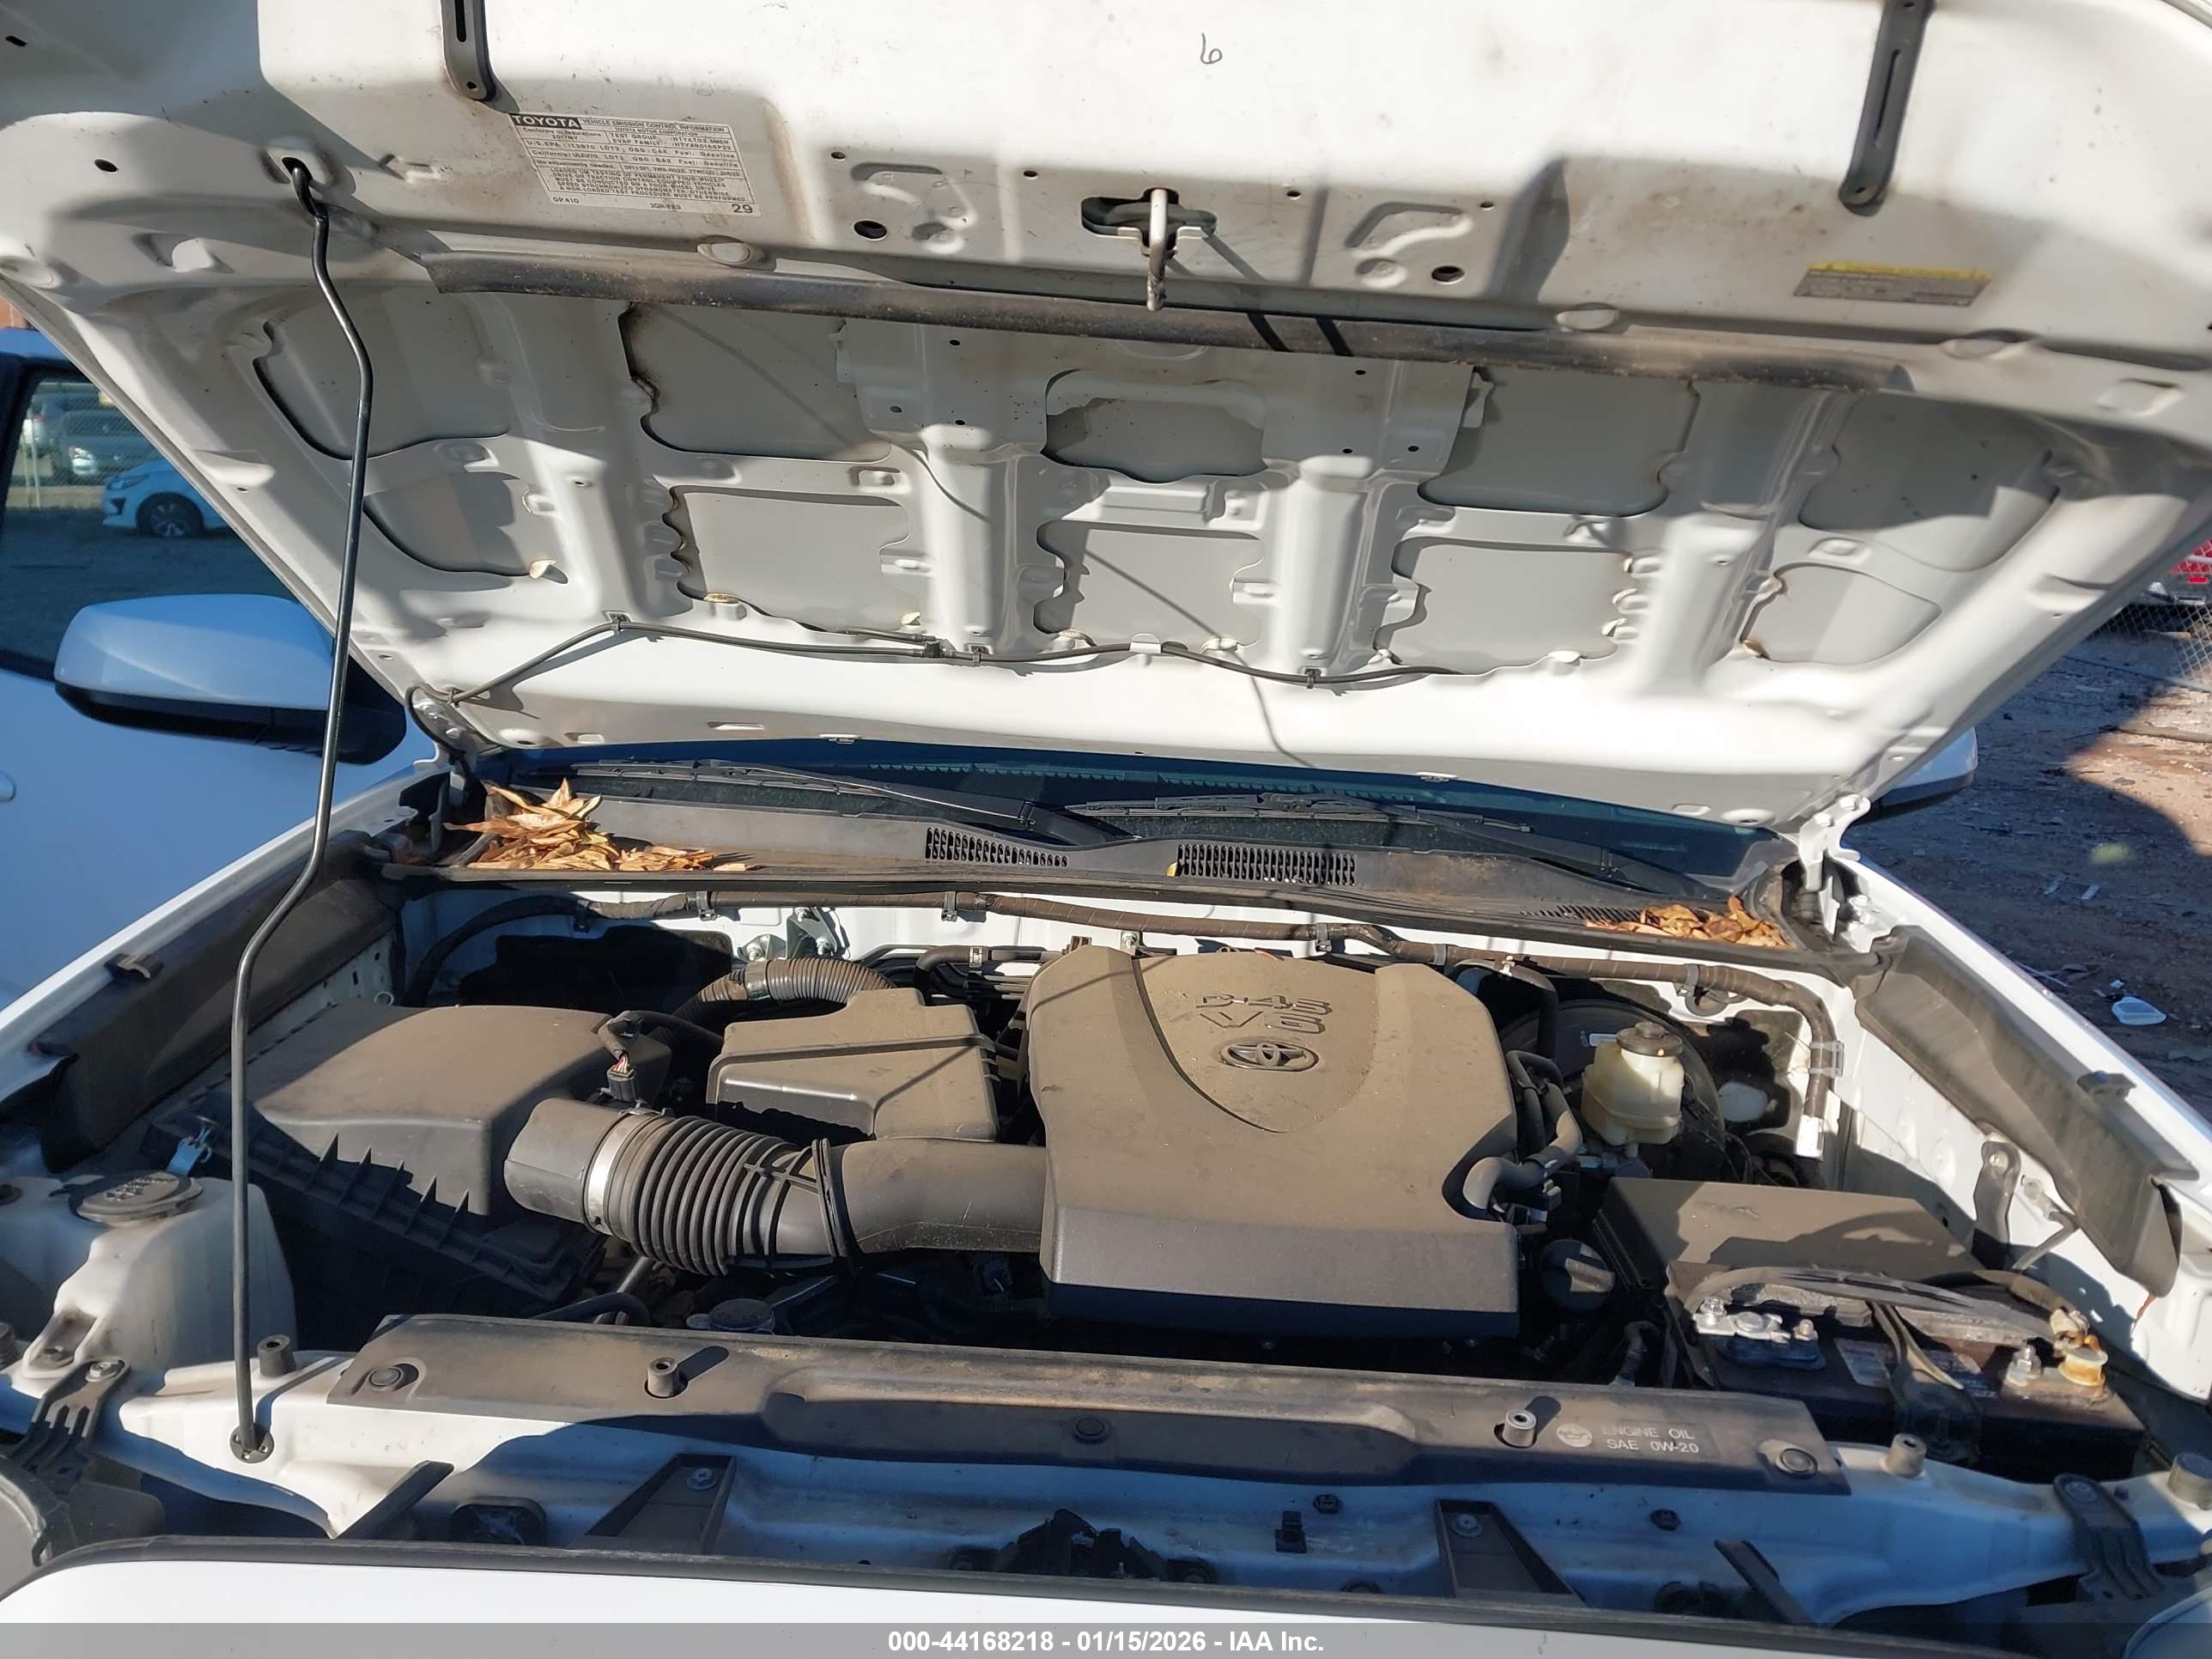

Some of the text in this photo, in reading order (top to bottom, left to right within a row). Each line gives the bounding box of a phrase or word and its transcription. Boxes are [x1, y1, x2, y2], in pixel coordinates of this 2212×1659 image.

[511, 115, 580, 128] TOYOTA
[732, 204, 753, 214] 29
[1603, 1426, 1696, 1440] ENGINE OIL
[1607, 1438, 1699, 1454] SAE 0W-20
